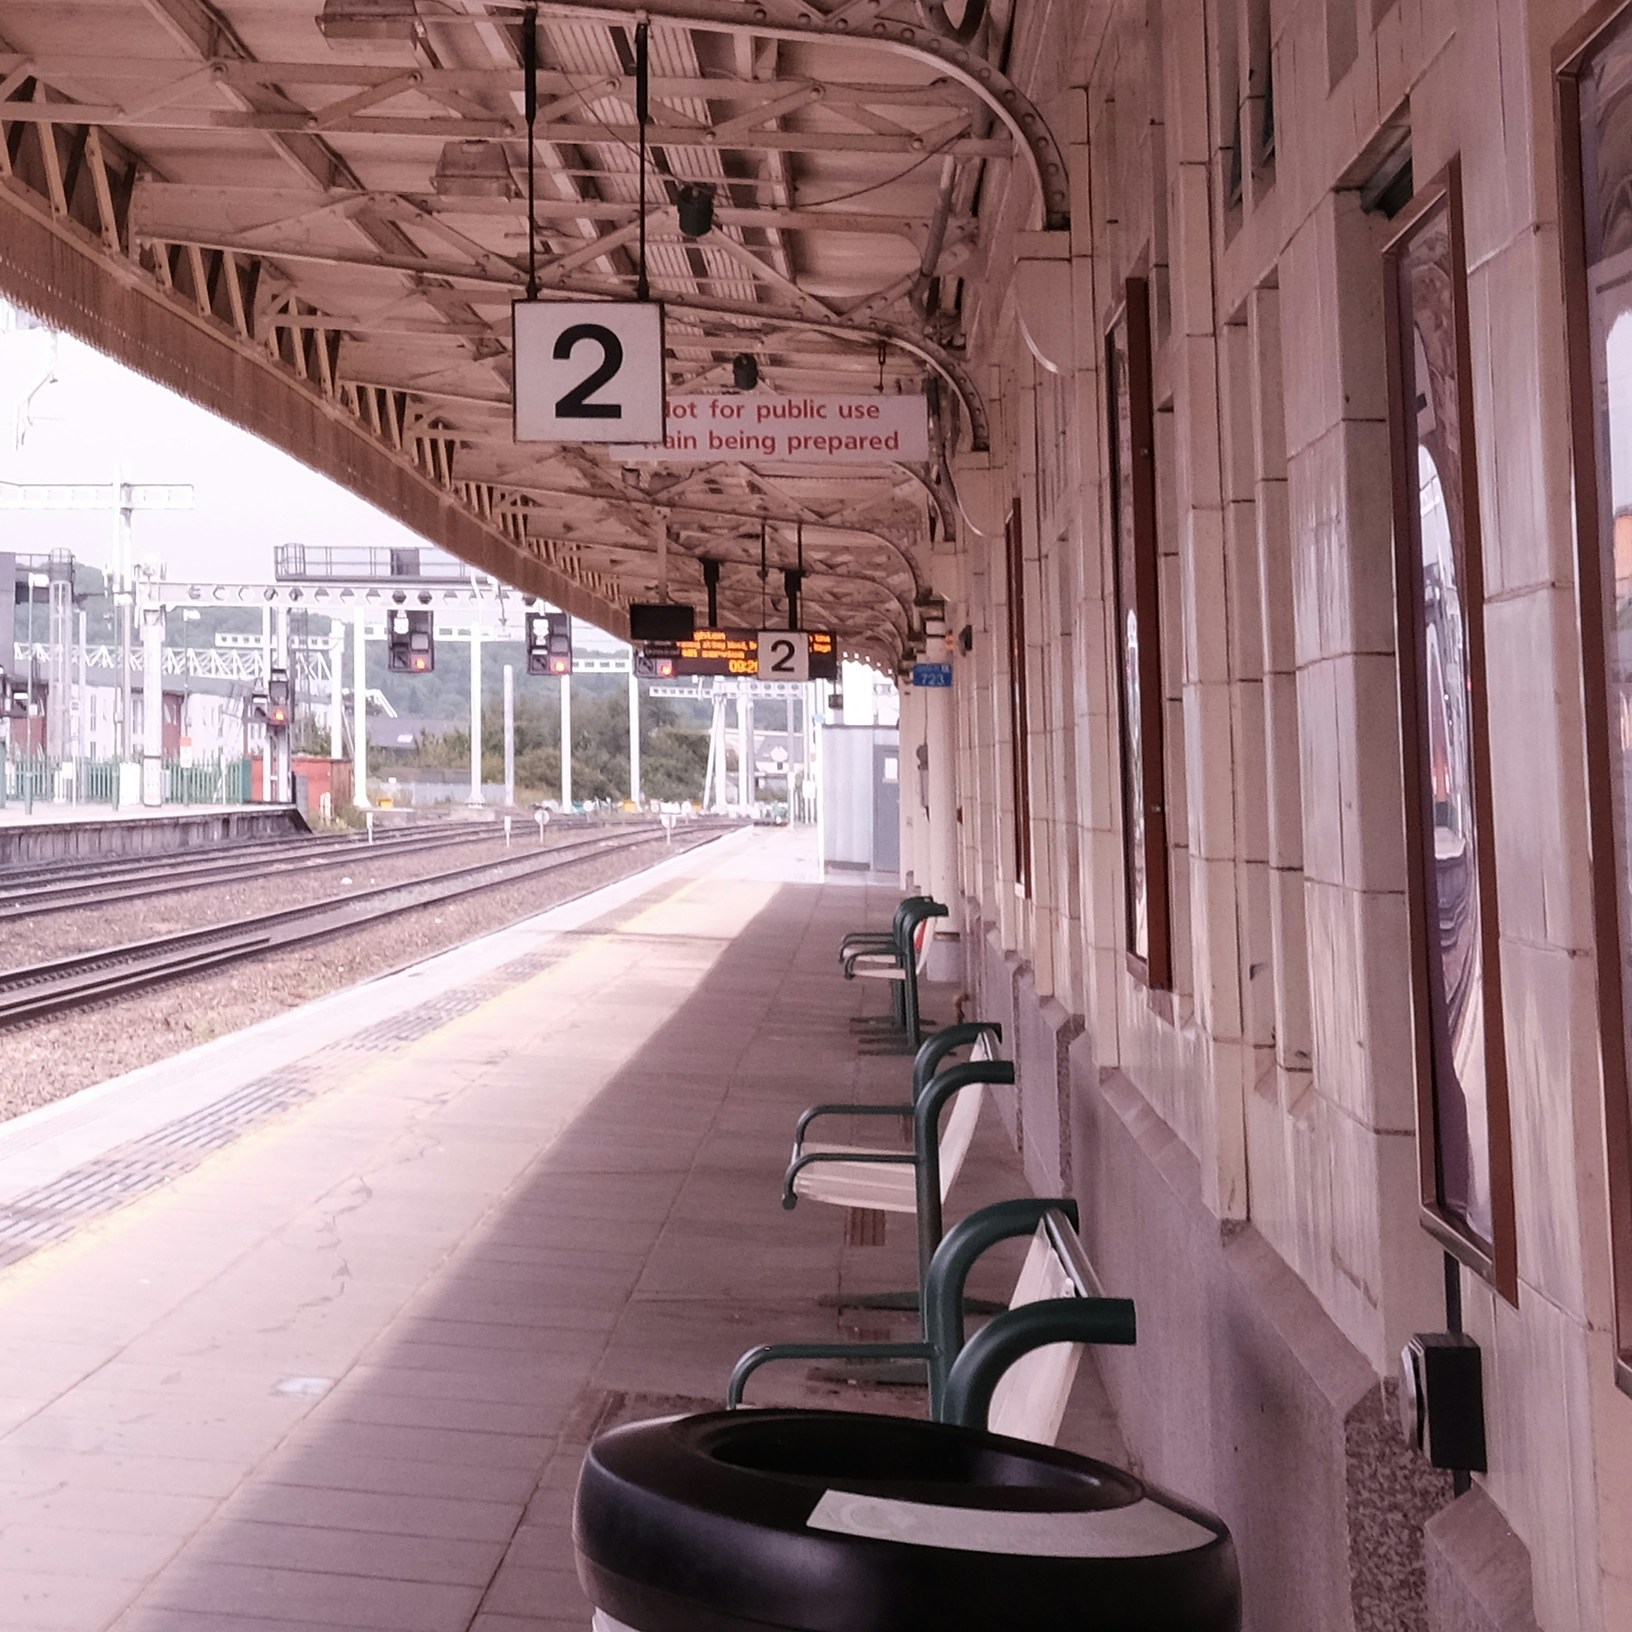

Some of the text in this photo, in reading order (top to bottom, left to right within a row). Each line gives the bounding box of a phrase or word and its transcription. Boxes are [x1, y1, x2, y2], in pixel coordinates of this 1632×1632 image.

[552, 323, 624, 420] 2
[709, 400, 744, 419] for
[756, 399, 828, 423] public
[839, 403, 880, 419] use
[664, 430, 900, 455] ain being prepared
[771, 639, 796, 672] 2
[921, 673, 945, 686] 723
